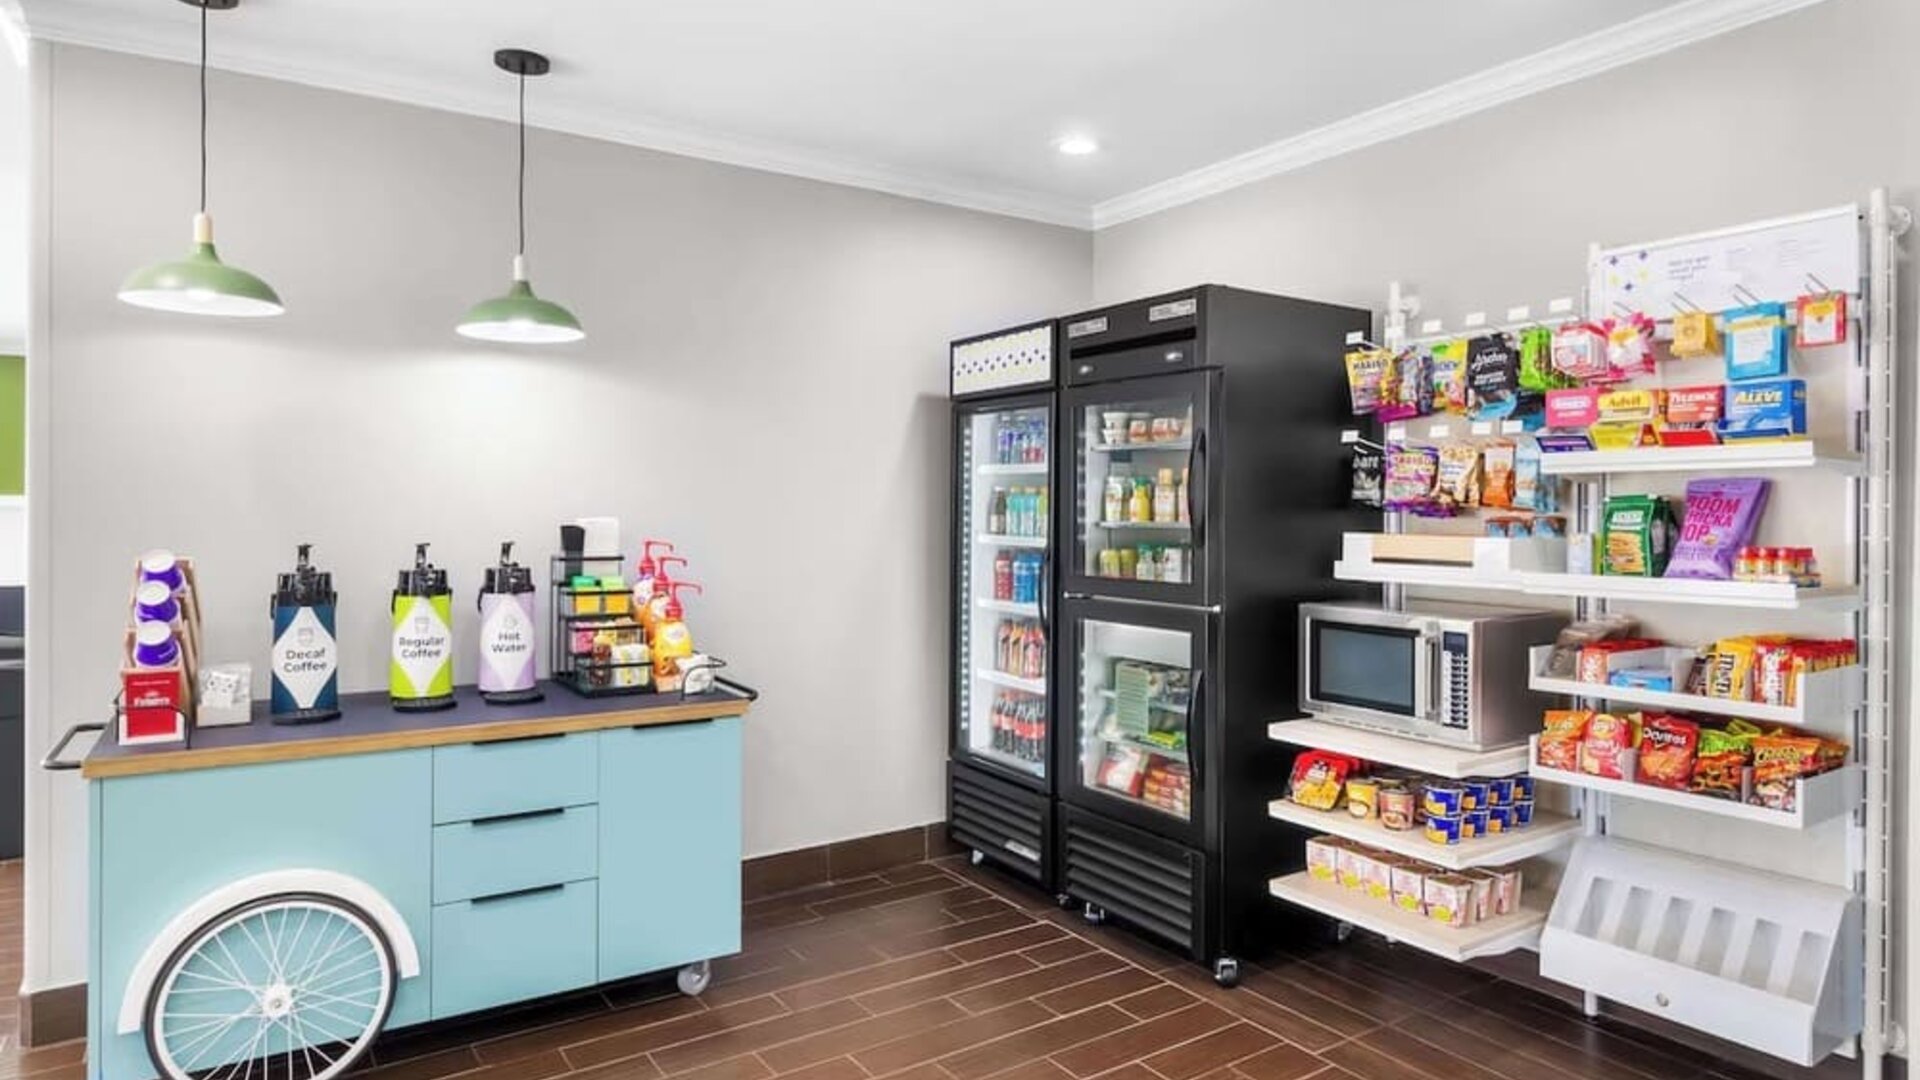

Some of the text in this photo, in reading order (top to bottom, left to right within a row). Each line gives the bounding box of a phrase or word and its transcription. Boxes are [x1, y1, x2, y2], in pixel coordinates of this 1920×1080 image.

[398, 636, 445, 648] Regular
[498, 631, 522, 641] Hot
[285, 647, 326, 660] Decaf
[401, 648, 442, 659] Coffee
[490, 643, 528, 653] Water
[283, 661, 328, 673] Coffee
[1642, 726, 1687, 746] Doritos
